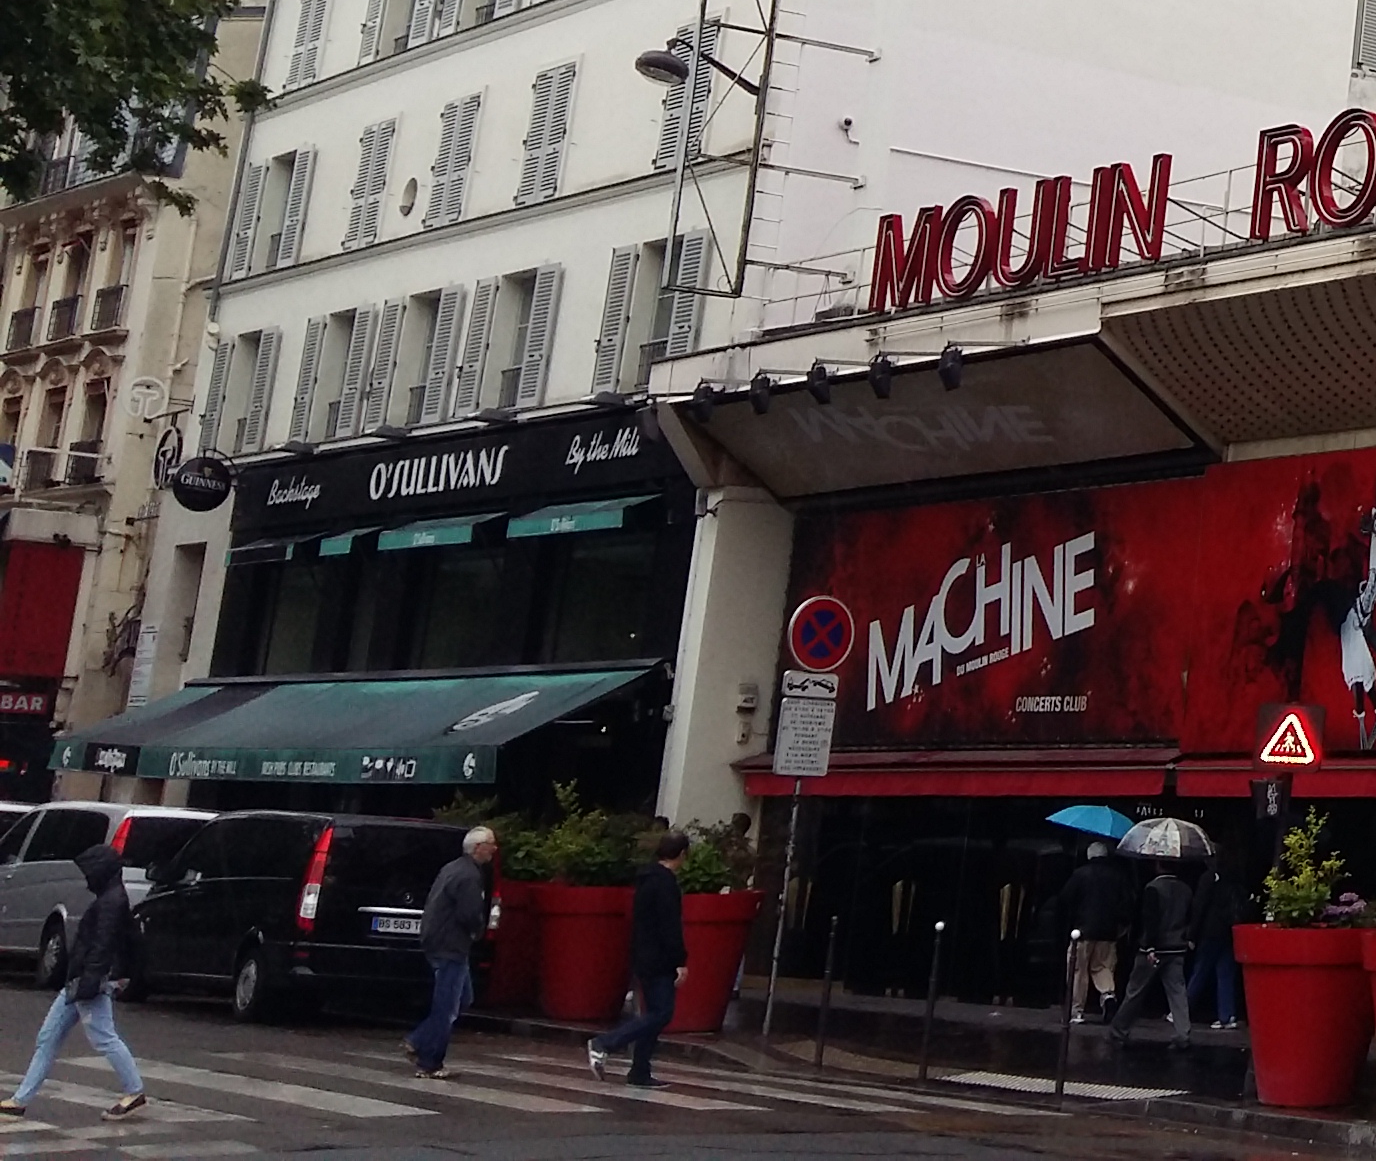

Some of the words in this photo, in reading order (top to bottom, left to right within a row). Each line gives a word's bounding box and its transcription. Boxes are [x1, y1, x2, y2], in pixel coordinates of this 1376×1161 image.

[869, 153, 1172, 313] MOULIN
[565, 436, 584, 474] By
[586, 430, 608, 461] the
[608, 427, 641, 459] Mill
[180, 472, 226, 490] GUINNESS
[267, 474, 321, 509] Backstage
[369, 445, 509, 500] O'SULLIVANS
[867, 531, 1095, 712] MACHINE
[1, 694, 43, 710] BAR
[1016, 696, 1061, 713] CONCERTS
[1063, 695, 1088, 712] CLUB
